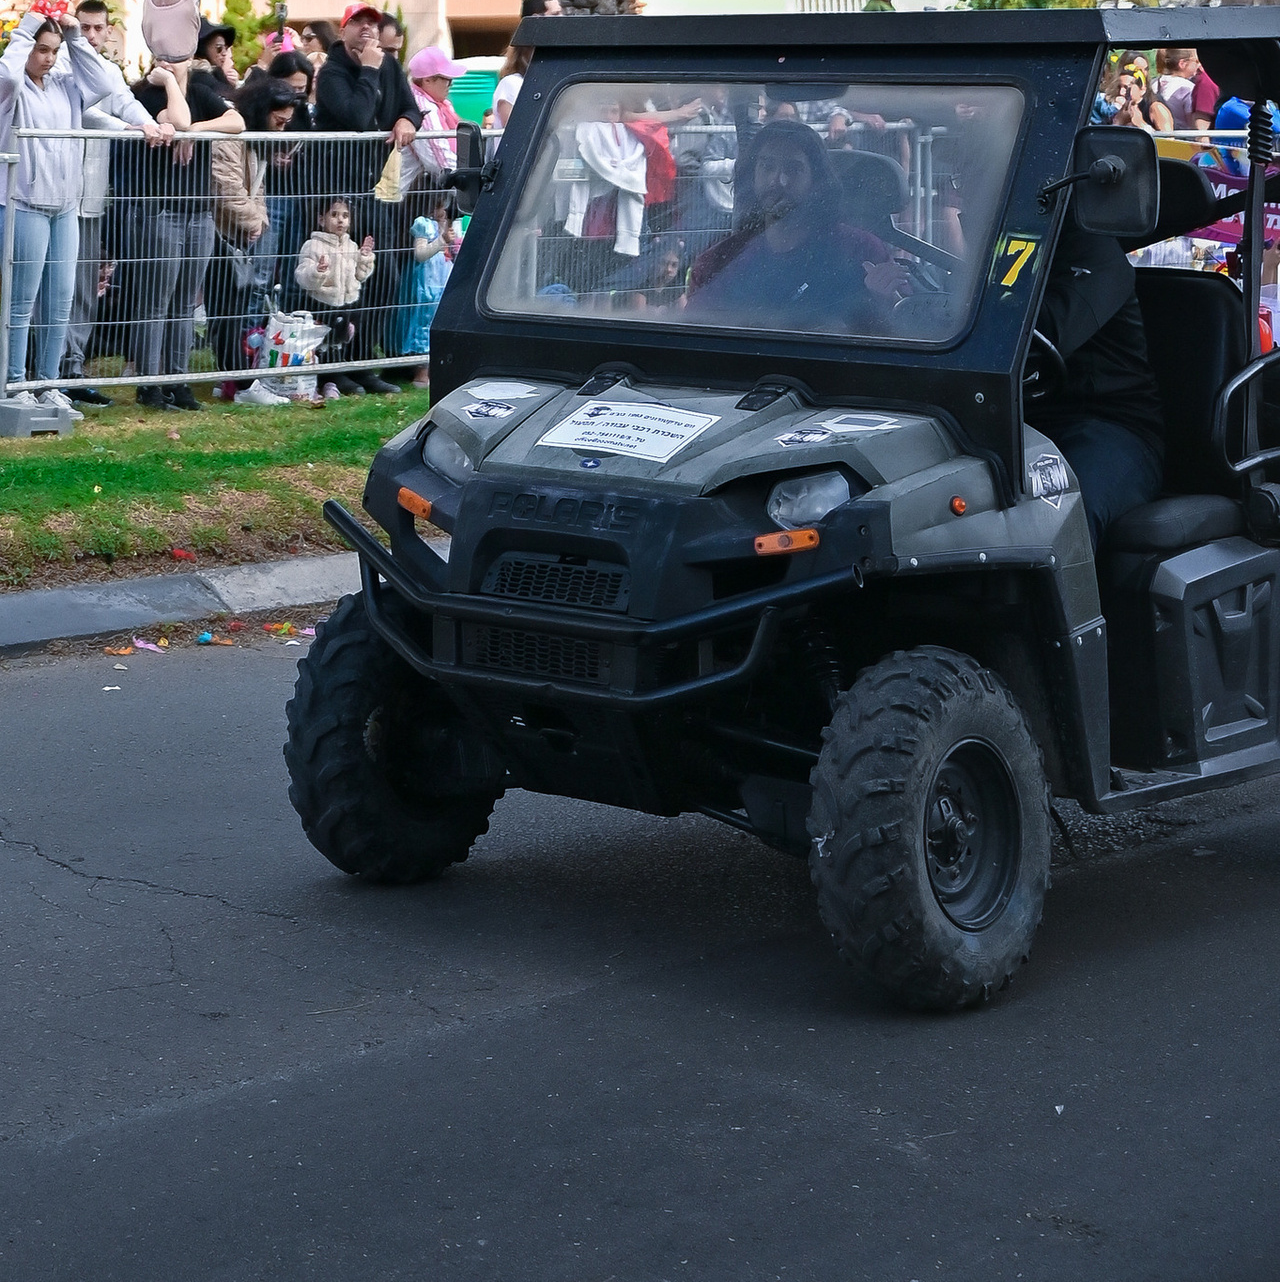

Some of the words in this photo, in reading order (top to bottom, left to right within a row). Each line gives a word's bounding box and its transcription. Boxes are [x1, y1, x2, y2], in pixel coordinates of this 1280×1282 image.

[1001, 240, 1036, 287] 7
[602, 421, 630, 429] עבודה
[632, 424, 652, 433] רכבי
[651, 428, 685, 440] השכרת
[487, 491, 641, 534] POLARIS
